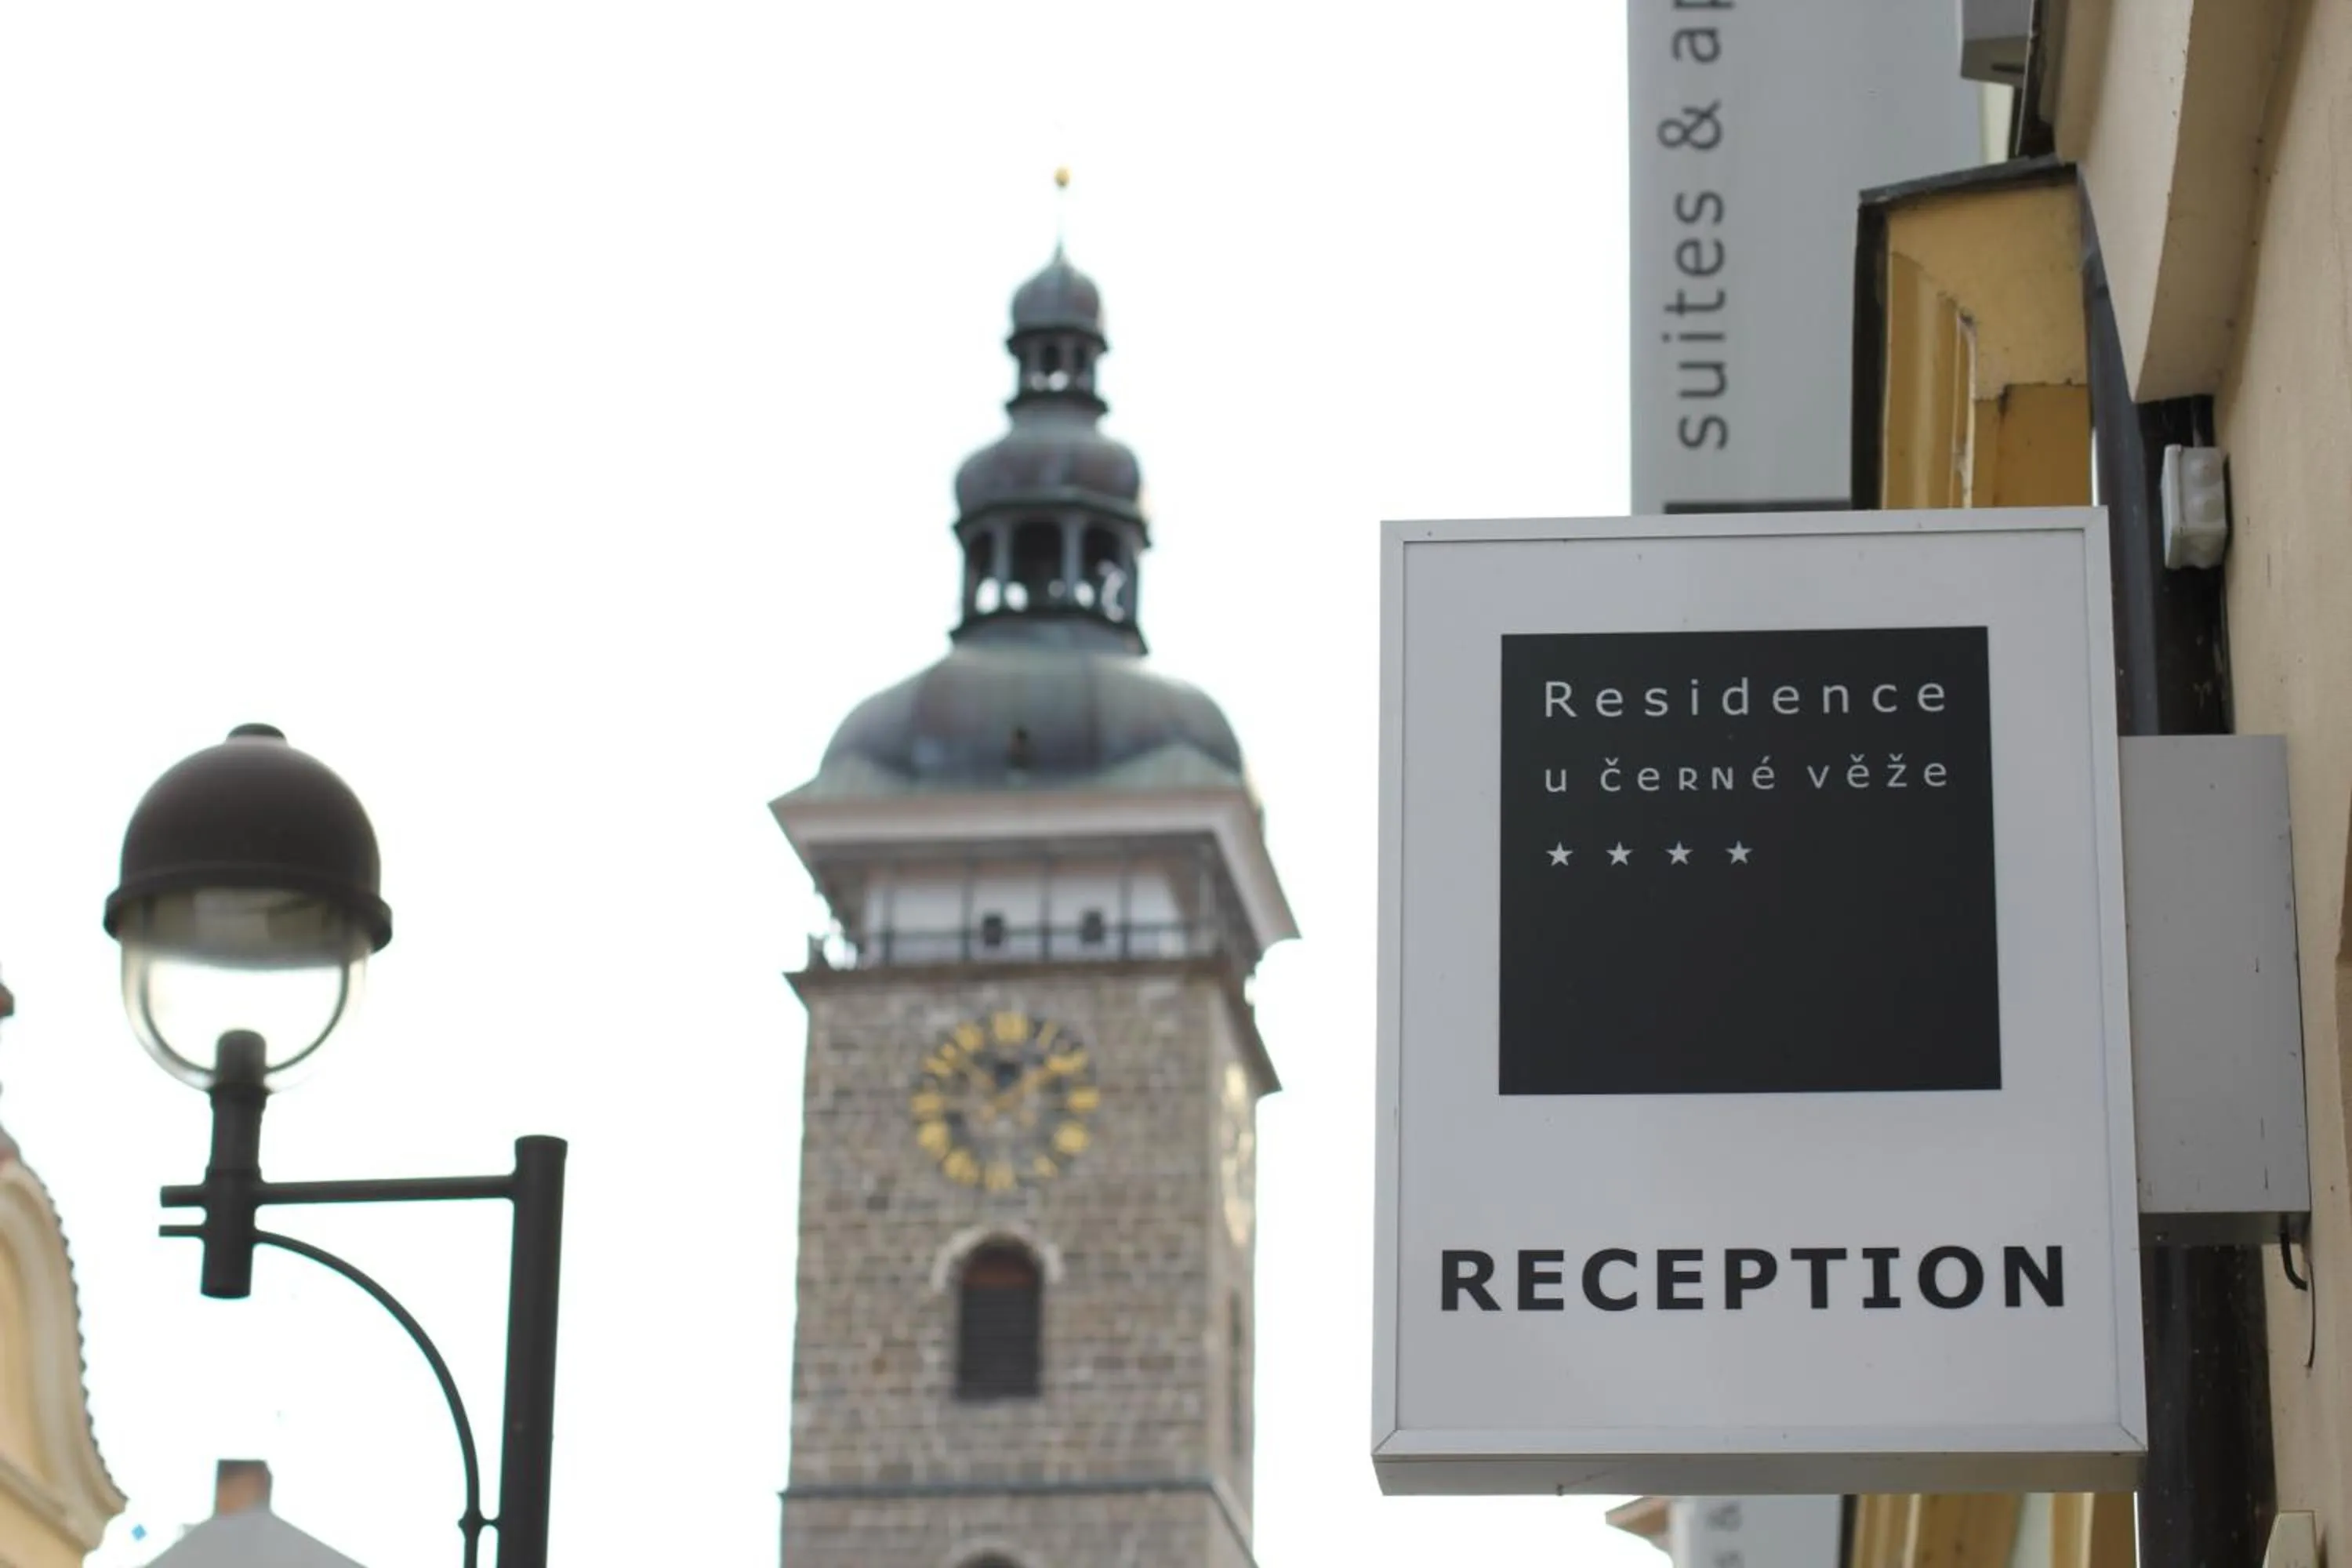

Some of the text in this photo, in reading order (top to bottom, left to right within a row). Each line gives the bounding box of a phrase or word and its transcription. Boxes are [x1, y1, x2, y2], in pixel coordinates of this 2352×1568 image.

[1657, 100, 1722, 151] &
[1661, 191, 1729, 450] suites
[1544, 677, 1946, 718] Residence
[1544, 768, 1568, 793] u
[1806, 753, 1947, 789] věže
[1440, 1245, 2065, 1312] RECEPTION
